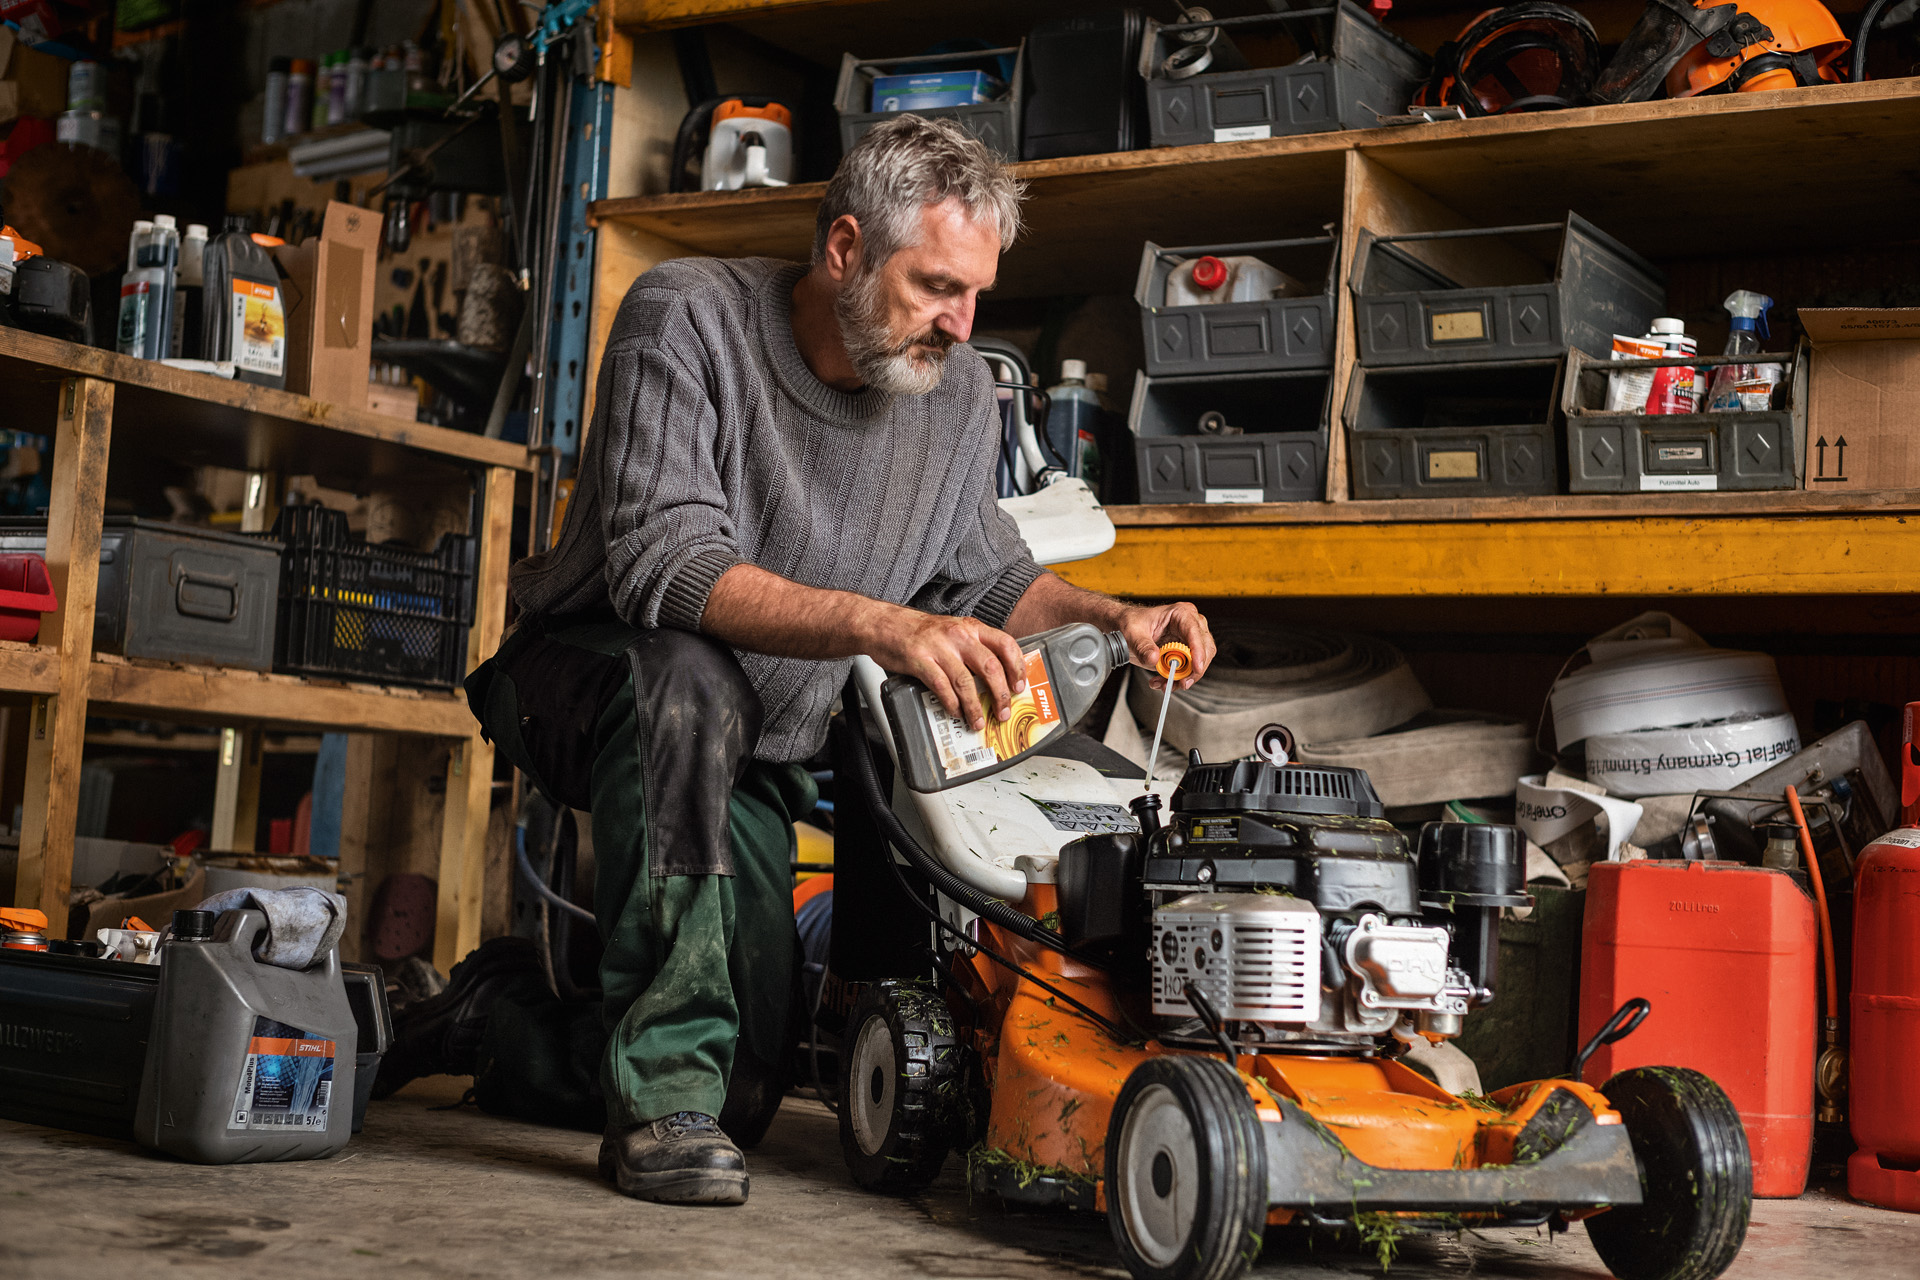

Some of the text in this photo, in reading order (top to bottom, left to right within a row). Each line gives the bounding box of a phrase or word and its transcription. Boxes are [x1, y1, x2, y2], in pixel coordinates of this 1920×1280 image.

[1640, 346, 1661, 357] STIHL
[1036, 688, 1052, 719] STIHL
[1656, 751, 1741, 770] Germany
[1745, 738, 1796, 764] OneFlat
[298, 1043, 322, 1052] STIHL
[244, 1057, 255, 1094] Moto4Plus
